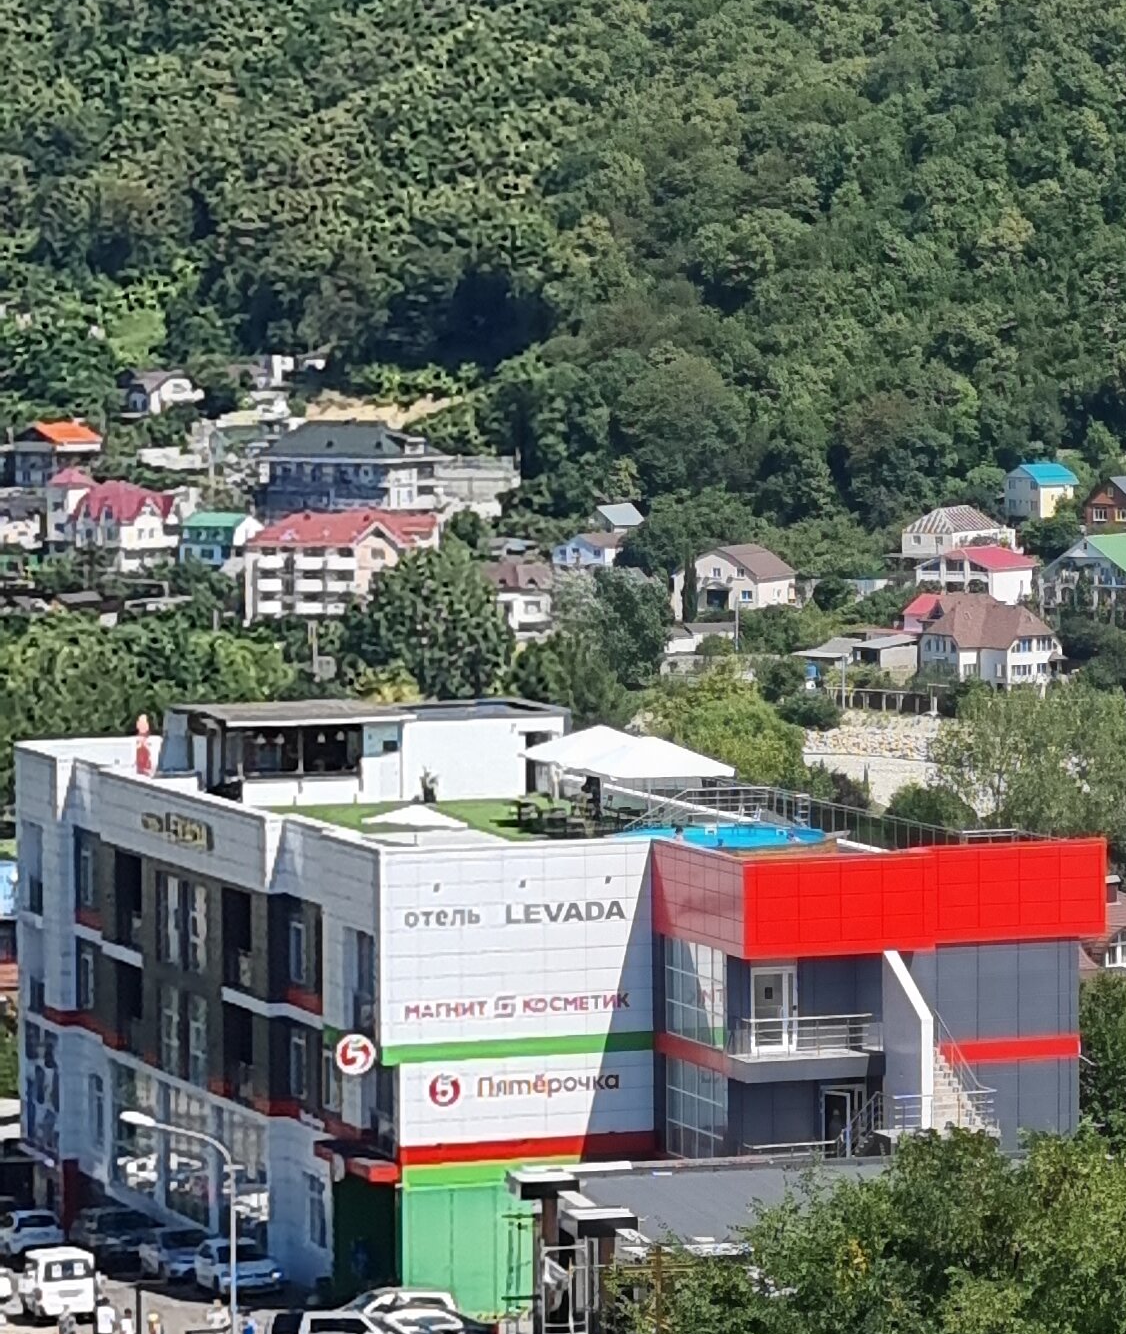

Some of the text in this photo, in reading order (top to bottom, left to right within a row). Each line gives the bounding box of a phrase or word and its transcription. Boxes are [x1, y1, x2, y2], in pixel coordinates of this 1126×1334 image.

[404, 900, 627, 929] отель LEVADA
[404, 992, 631, 1021] МАГНИТ КОСМЕТИК
[477, 1073, 620, 1099] Пятёрочка
